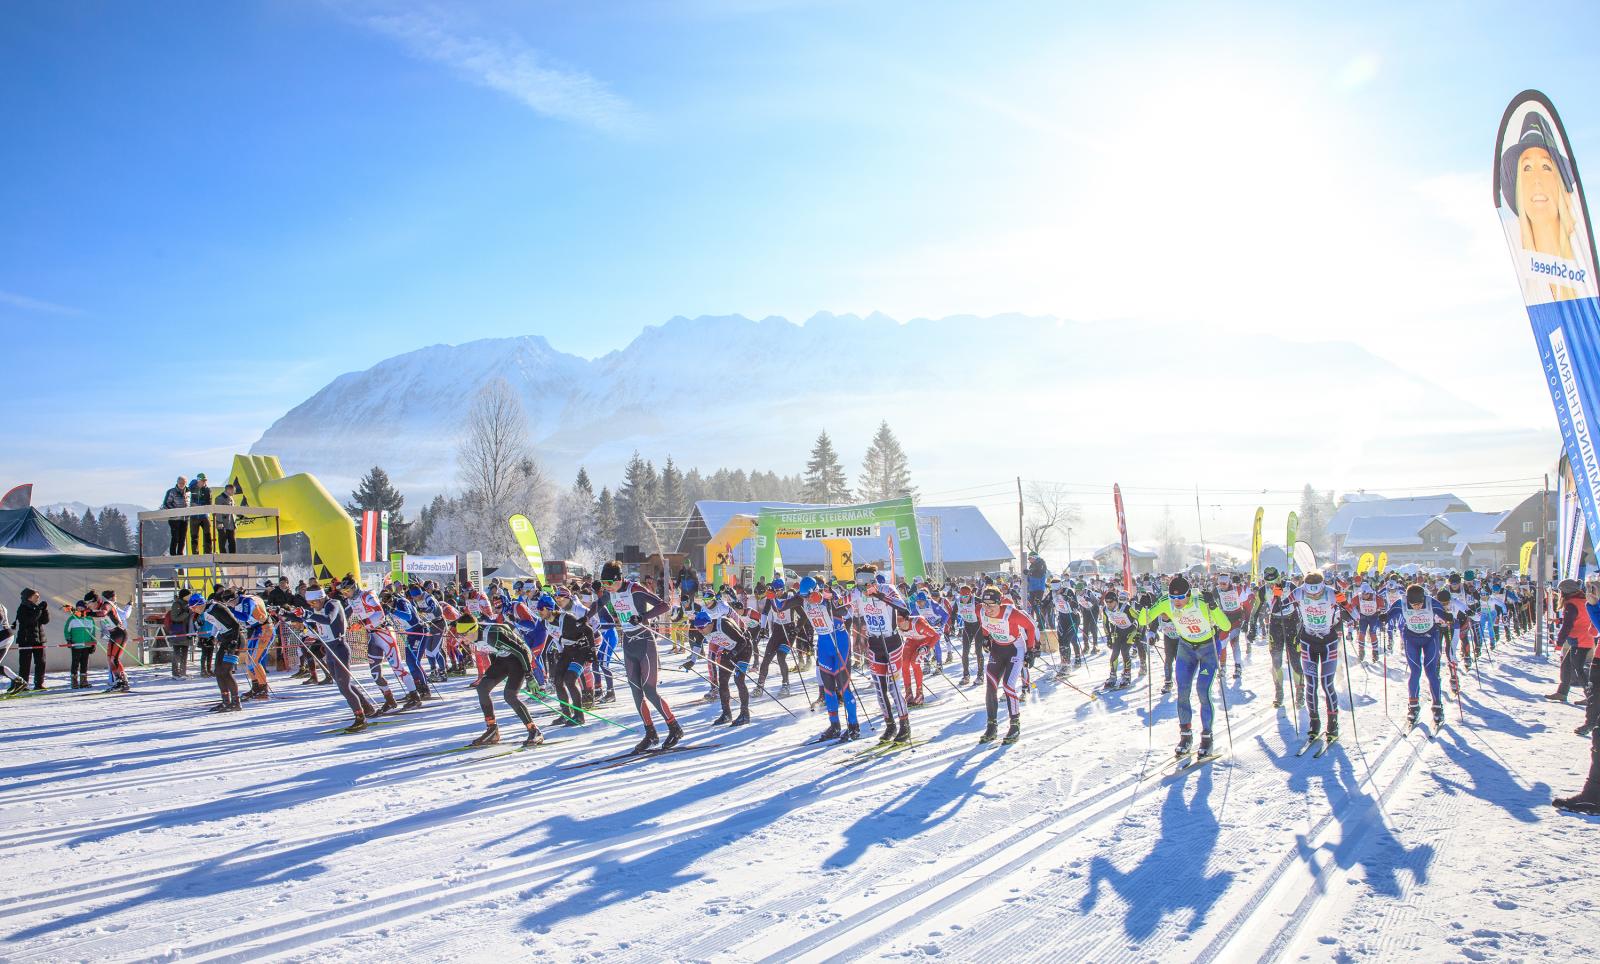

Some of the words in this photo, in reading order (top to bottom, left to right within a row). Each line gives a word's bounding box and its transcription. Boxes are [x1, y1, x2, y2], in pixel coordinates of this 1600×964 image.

[781, 512, 817, 524] ENERGIE
[819, 508, 876, 523] STEIERMARK
[805, 528, 828, 539] ZIEL
[836, 526, 871, 537] FINISH
[865, 614, 886, 627] 363
[1187, 624, 1201, 634] 19
